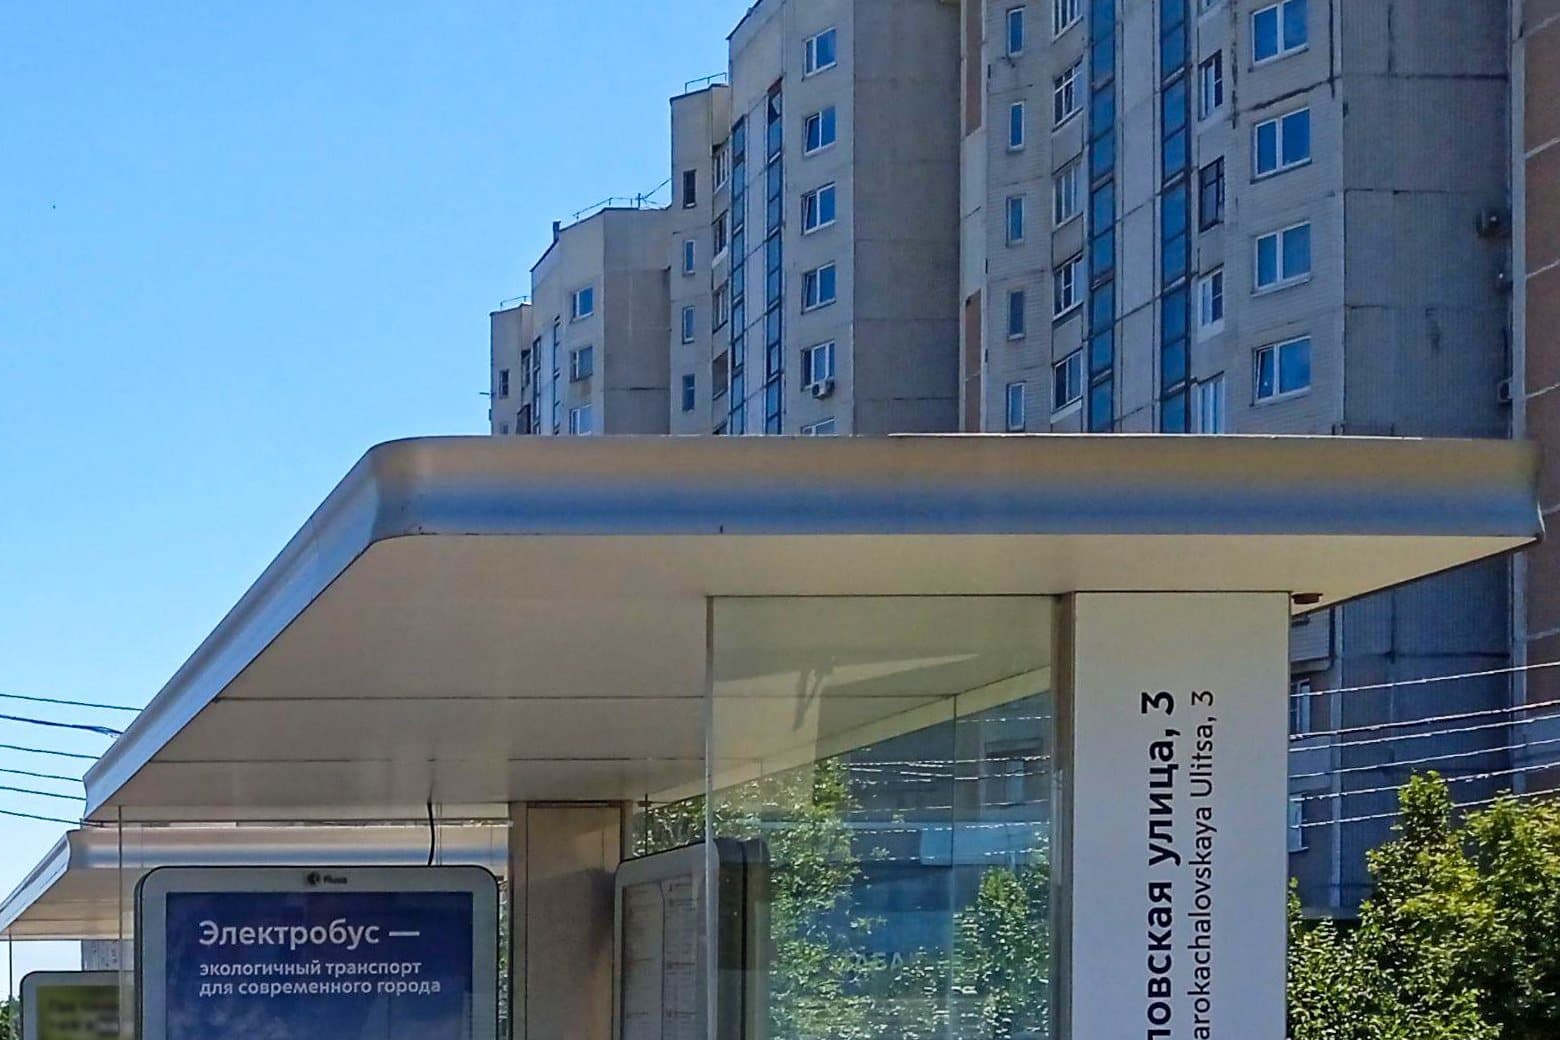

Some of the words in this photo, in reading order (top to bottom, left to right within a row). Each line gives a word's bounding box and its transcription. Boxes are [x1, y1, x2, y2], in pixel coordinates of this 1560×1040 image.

[1140, 691, 1175, 716] 3
[1190, 690, 1214, 707] 3
[1188, 716, 1218, 798] Ulitsa,
[1148, 728, 1182, 867] улица,
[199, 918, 381, 951] Электробус
[199, 960, 321, 977] экологичный
[325, 961, 422, 979] транспорт
[199, 982, 234, 998] для
[239, 980, 372, 998] современного
[377, 979, 441, 998] города
